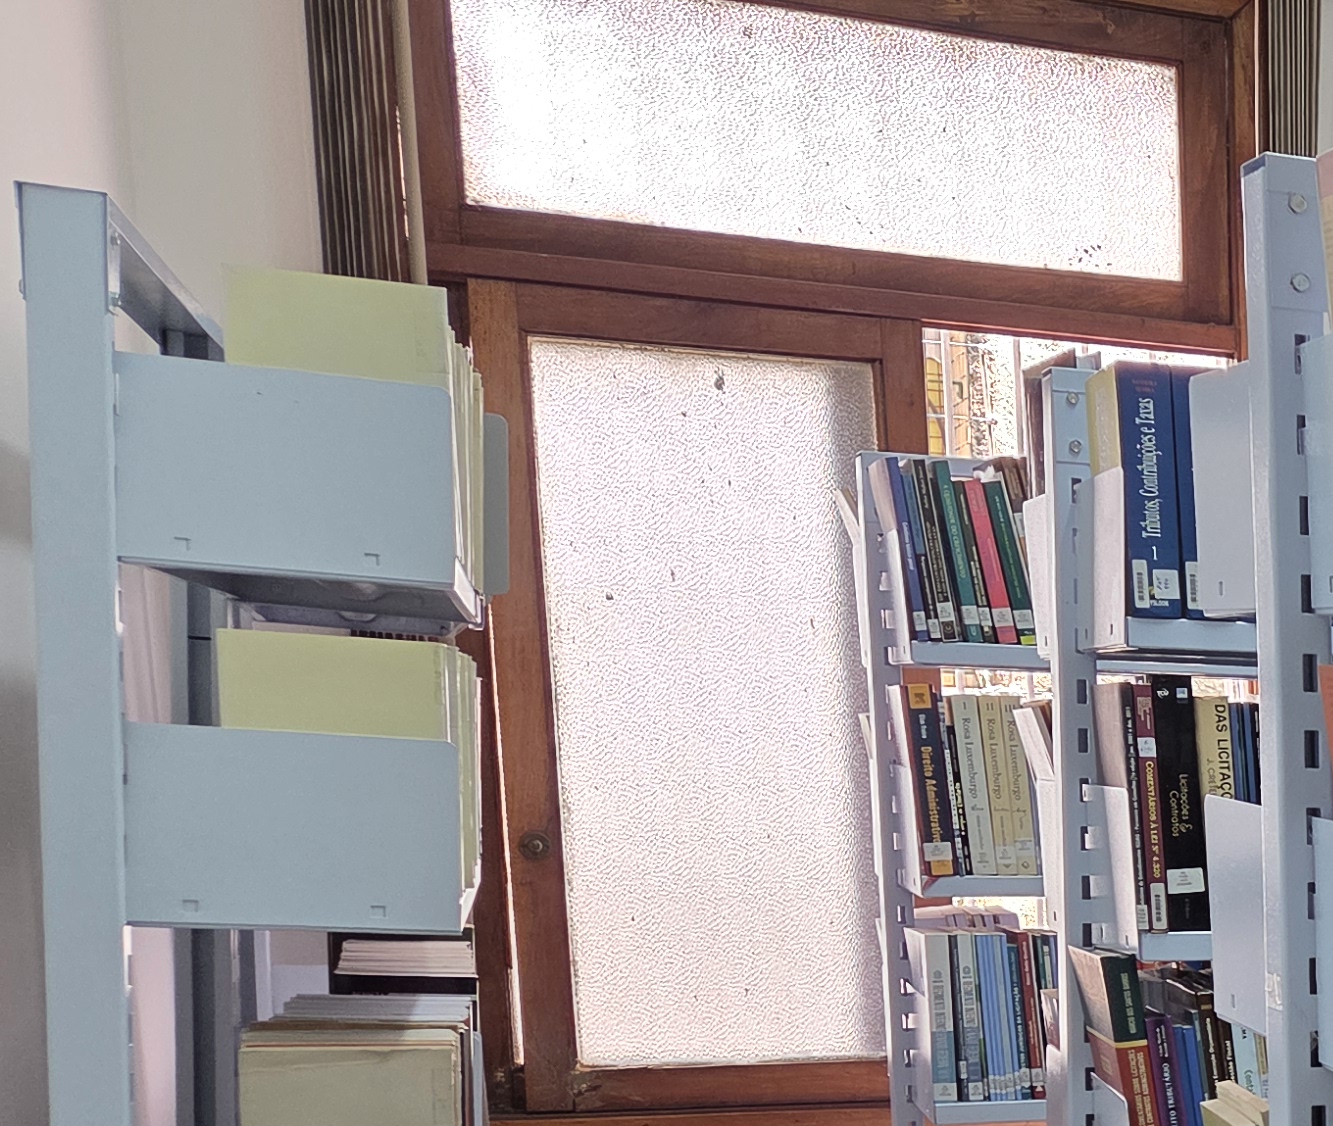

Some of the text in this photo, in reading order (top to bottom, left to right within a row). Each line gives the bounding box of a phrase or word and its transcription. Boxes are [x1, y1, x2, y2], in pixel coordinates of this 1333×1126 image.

[1135, 397, 1156, 426] Taxas
[1136, 434, 1162, 497] Contribuições
[1142, 499, 1163, 538] Tributos,
[1215, 704, 1227, 733] DAS
[921, 746, 934, 777] Direito
[962, 717, 978, 799] Rosa Luxemburgo
[986, 718, 1002, 800] Rosa Luxemburgo
[1169, 790, 1179, 837] Contratos
